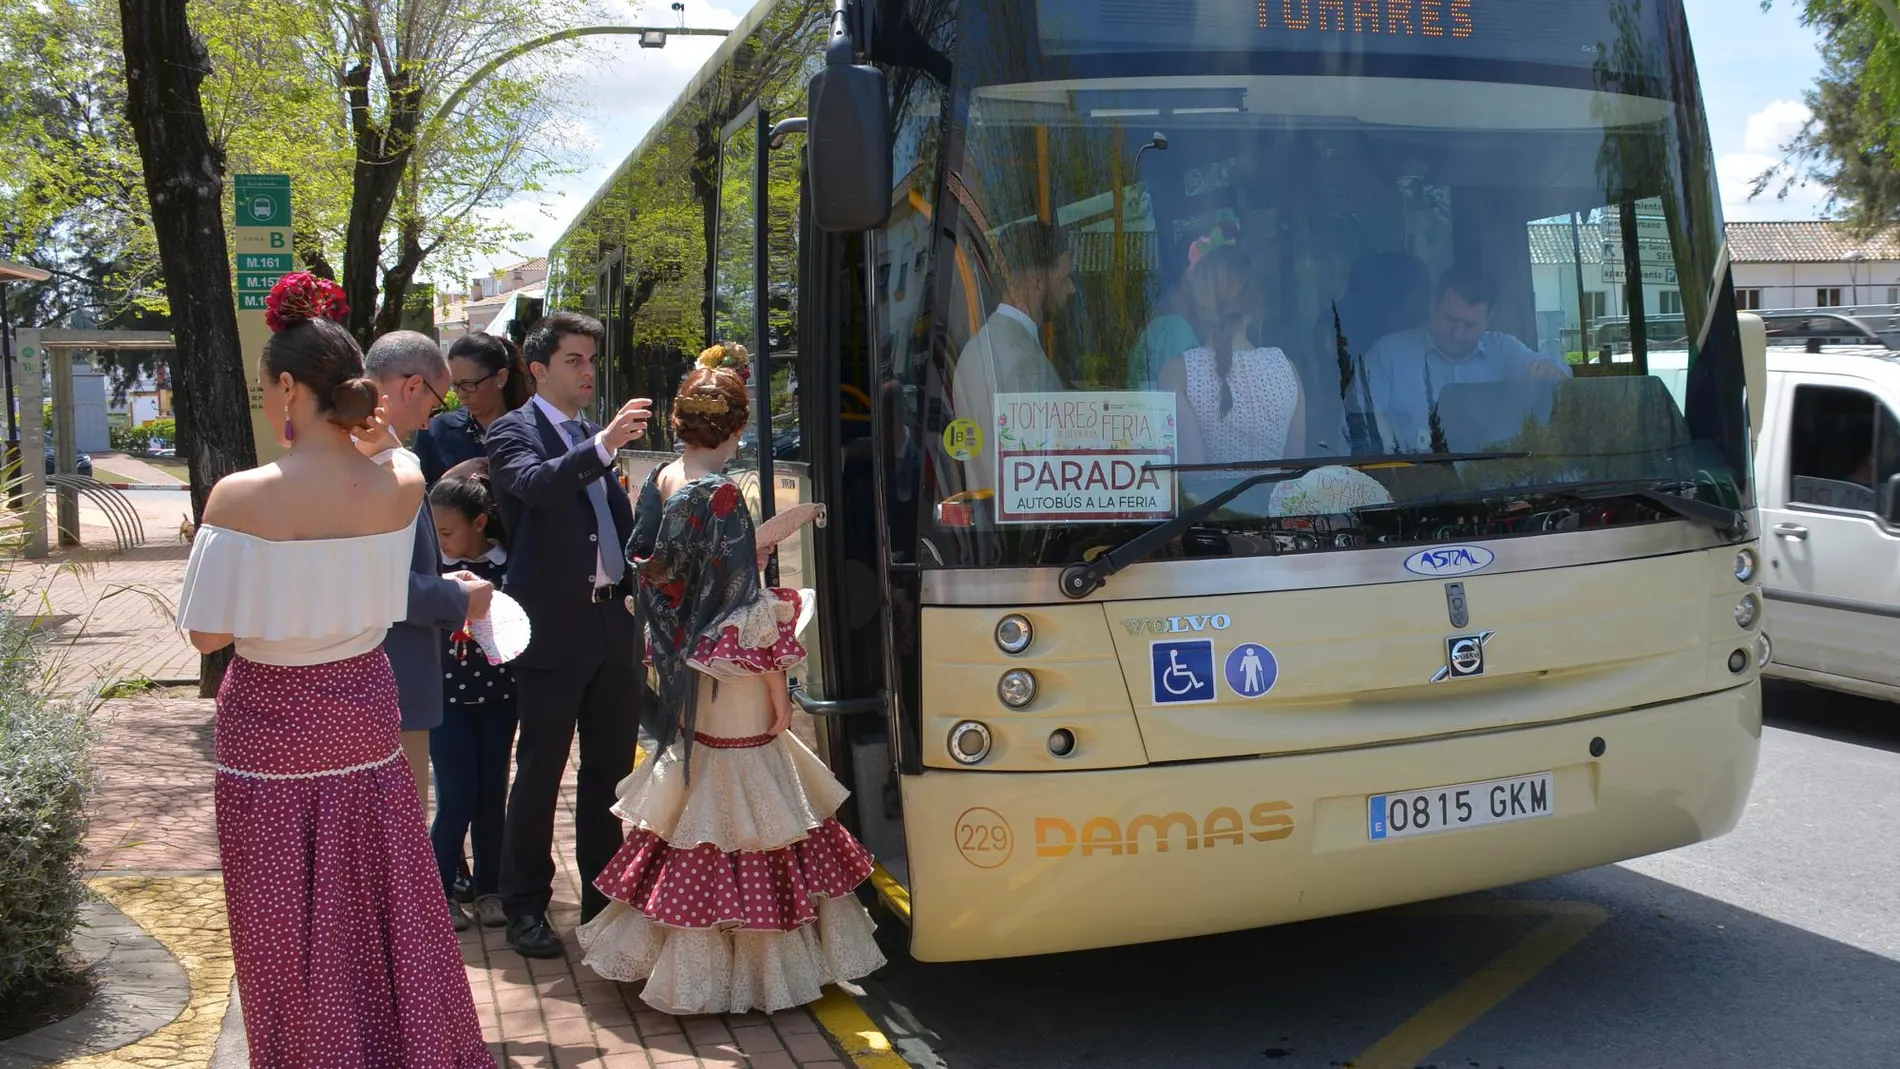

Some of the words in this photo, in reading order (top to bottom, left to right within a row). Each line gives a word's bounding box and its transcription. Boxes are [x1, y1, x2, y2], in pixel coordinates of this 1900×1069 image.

[1637, 221, 1661, 229] rbano
[270, 232, 285, 248] B
[246, 257, 280, 268] M.161
[244, 296, 265, 306] M.1
[1009, 401, 1098, 429] TOMARES
[1101, 414, 1153, 442] FERIA
[1014, 460, 1160, 492] PARADA
[1316, 472, 1377, 499] TOMARES
[1016, 493, 1082, 510] AUTOBÚS
[1085, 496, 1098, 509] A
[1098, 496, 1116, 509] LA
[1119, 496, 1158, 509] FERIA
[1420, 549, 1481, 572] ASTRAL
[1120, 613, 1232, 636] VOLVO
[1453, 651, 1480, 660] VOLVO
[1374, 822, 1383, 832] E
[1389, 790, 1473, 832] 0815
[1489, 778, 1548, 818] GKM
[960, 824, 1008, 852] 229
[1034, 800, 1294, 858] DAMAS
